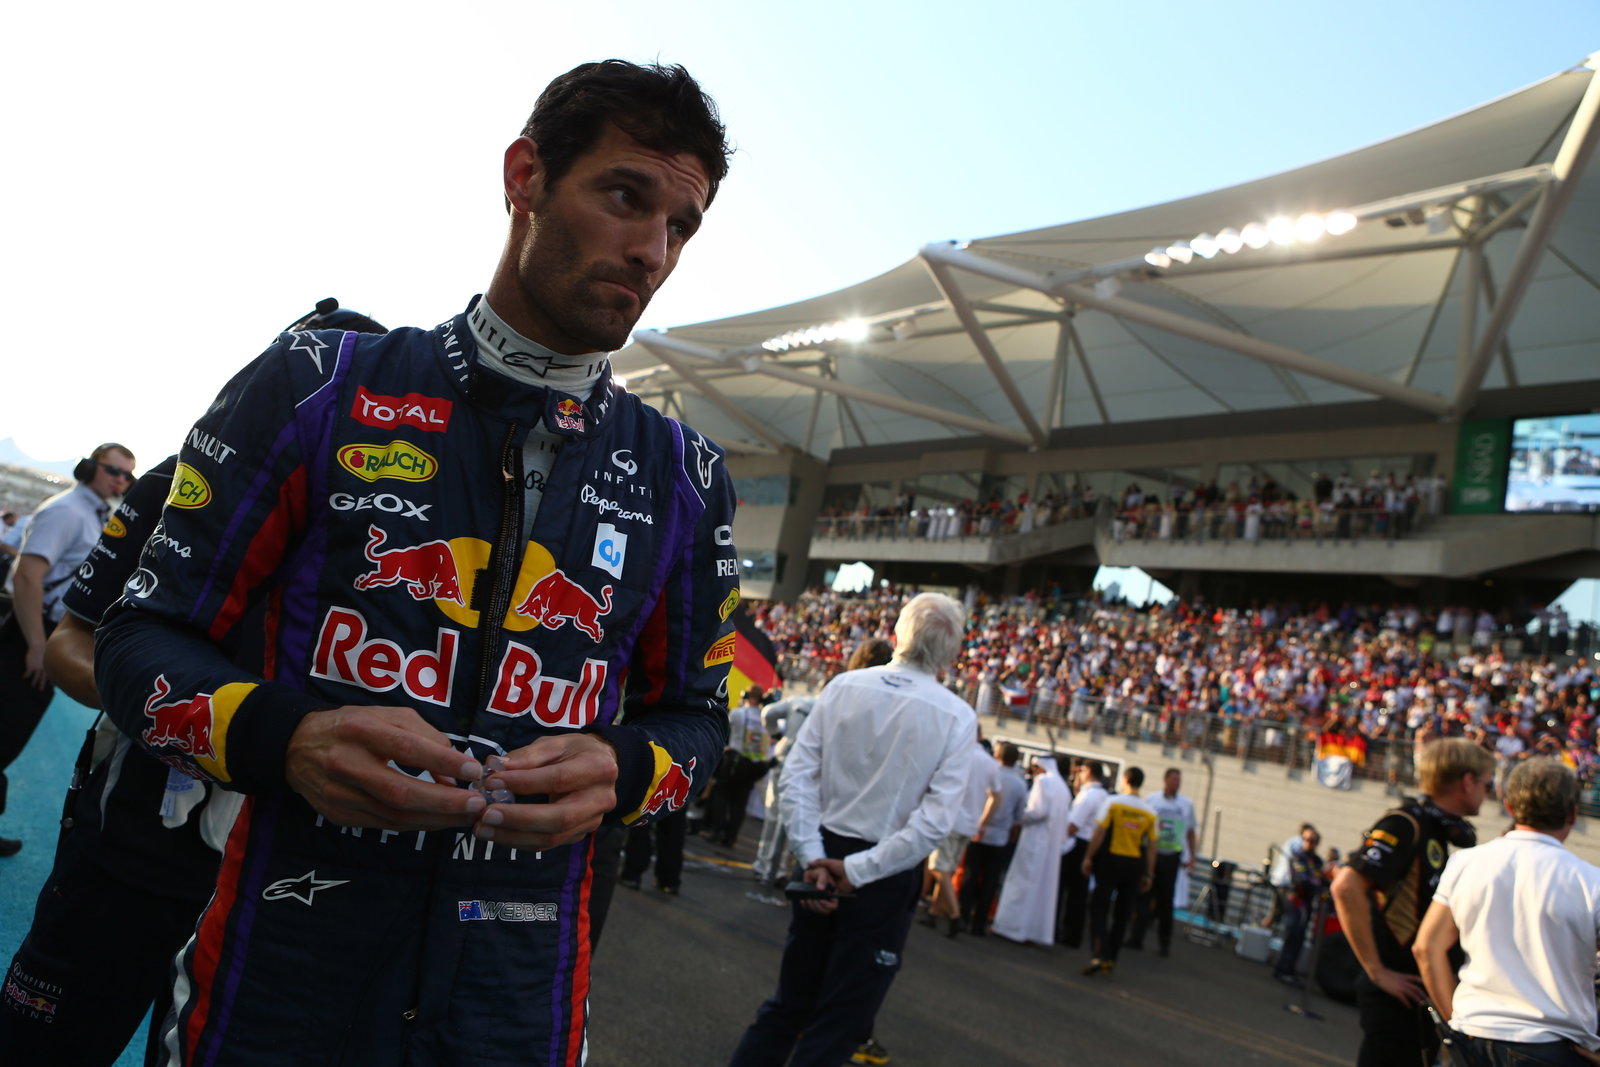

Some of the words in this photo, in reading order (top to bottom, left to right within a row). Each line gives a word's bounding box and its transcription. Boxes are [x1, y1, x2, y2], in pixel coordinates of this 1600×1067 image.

[360, 394, 445, 424] TOTAL
[365, 451, 427, 475] RAUCH
[329, 492, 433, 522] GEOX
[310, 606, 460, 708] Red
[486, 640, 608, 729] Bull
[481, 901, 558, 921] WEBBER
